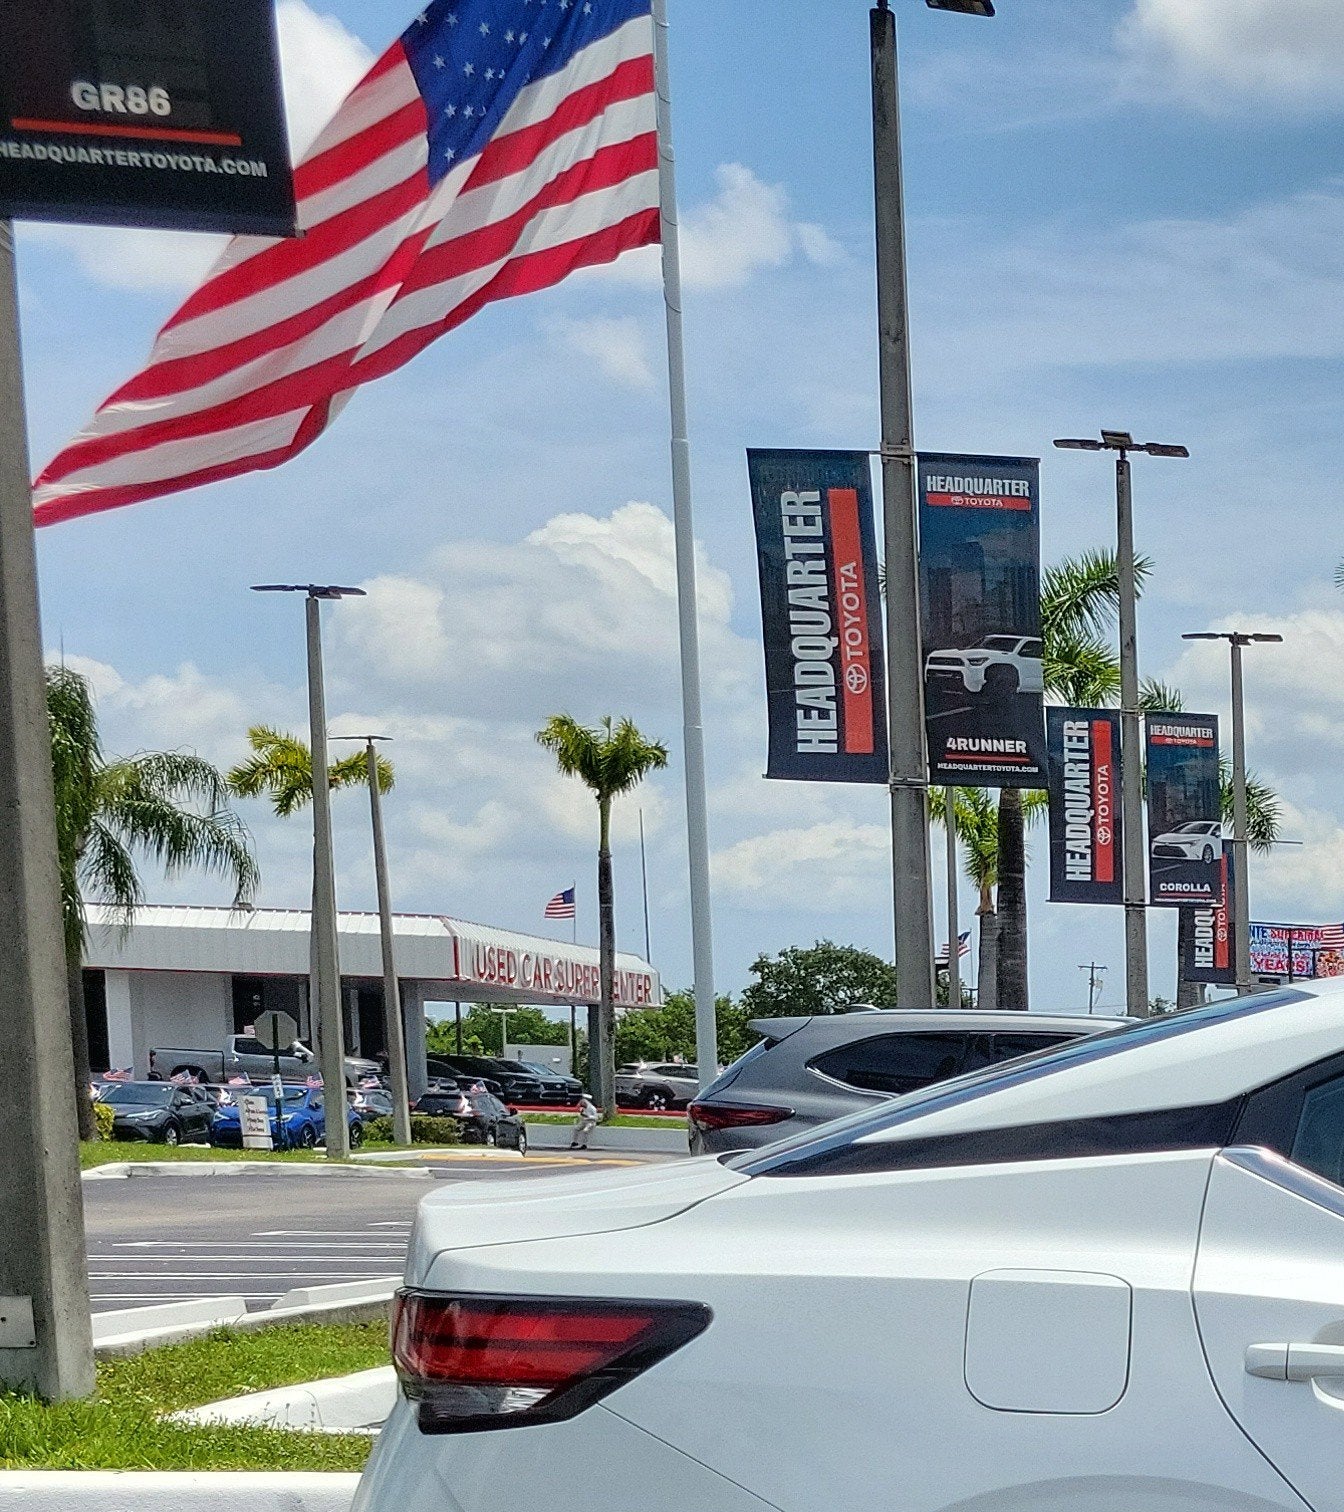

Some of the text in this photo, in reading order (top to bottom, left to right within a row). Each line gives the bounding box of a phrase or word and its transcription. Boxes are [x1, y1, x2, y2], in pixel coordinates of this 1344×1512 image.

[70, 81, 172, 116] GR86
[0, 142, 268, 178] HEADQUARTERTOYOTA.COM
[926, 475, 1030, 497] HEADQUARTER
[965, 497, 1003, 507] TOYOTA
[781, 490, 838, 753] HEADQUARTER
[840, 562, 863, 660] TOYOTA
[946, 737, 1027, 753] 4RUNNER
[1150, 725, 1213, 738] HEADQUARTER
[937, 762, 1039, 773] HEADQUARTERTOYOTA.COM
[1063, 720, 1094, 881] HEADQUARTER
[1098, 764, 1109, 824] TOYOTA
[1160, 883, 1211, 892] COROLLA
[473, 944, 652, 1003] USED CAR SUPER ENTER
